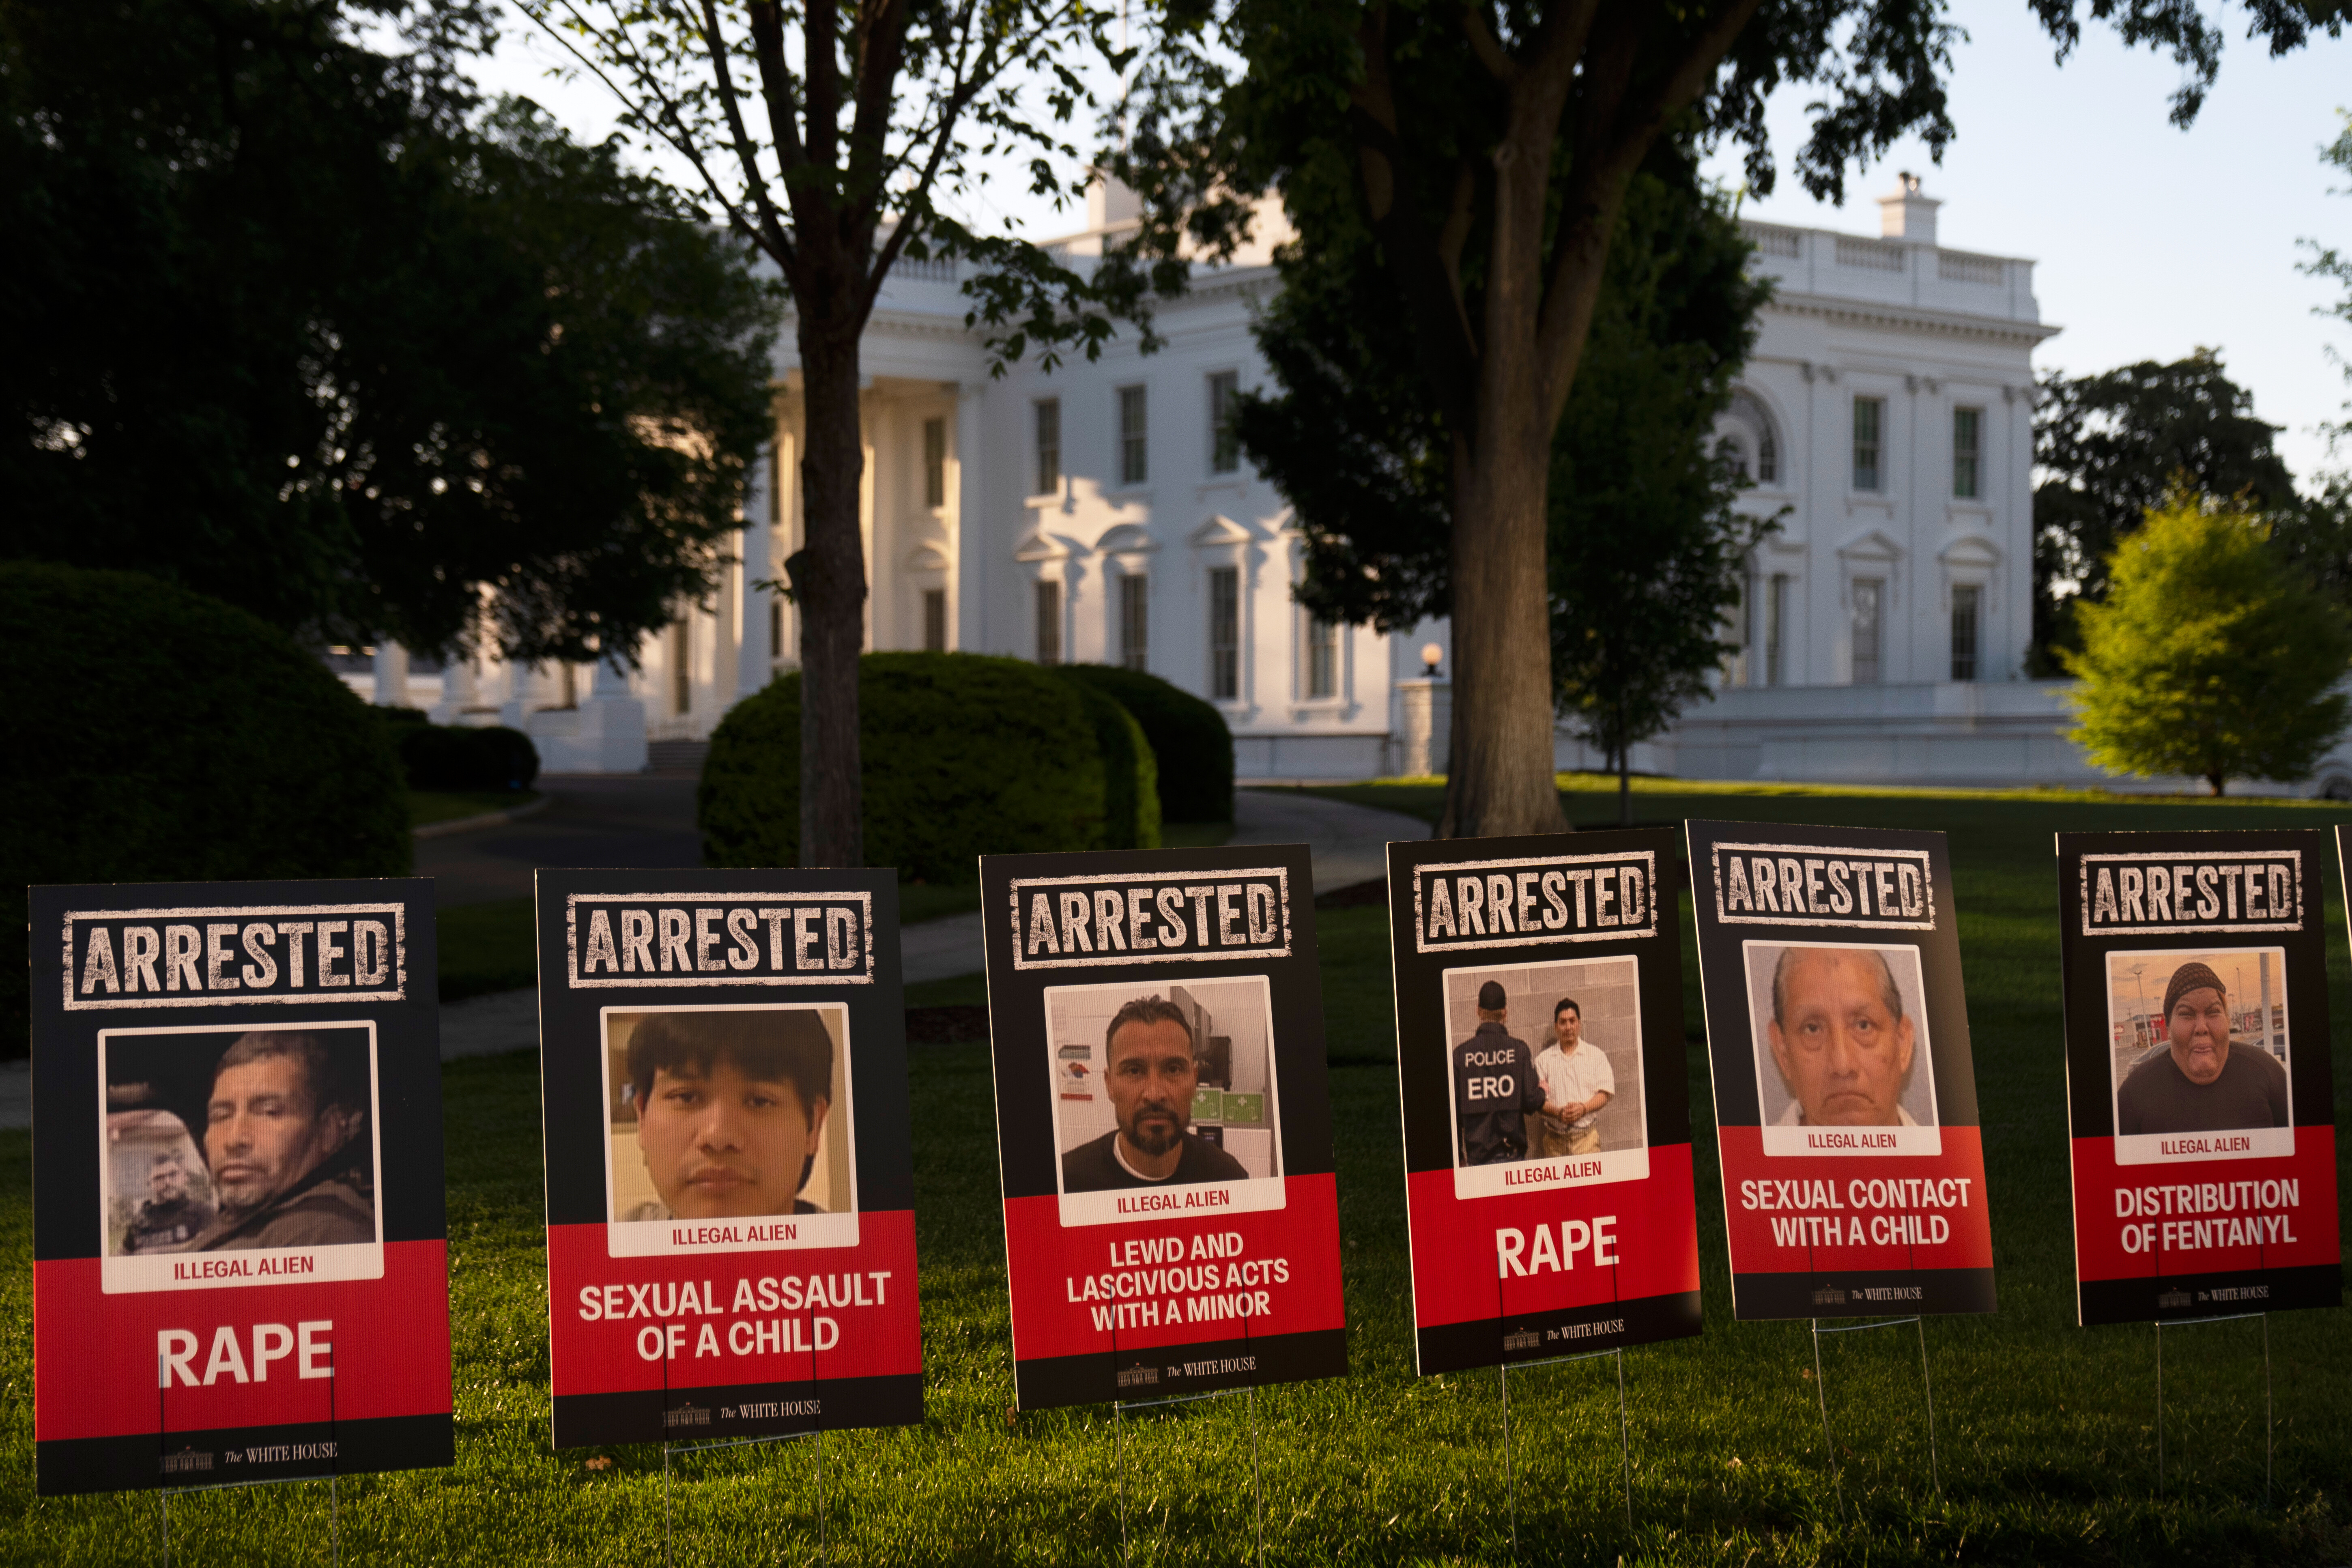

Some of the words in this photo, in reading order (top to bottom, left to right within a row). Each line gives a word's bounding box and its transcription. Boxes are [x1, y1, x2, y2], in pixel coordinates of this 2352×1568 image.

[1429, 867, 1645, 937] ARRESTED
[1729, 856, 1923, 917] ARRESTED
[2094, 865, 2291, 922] ARRESTED
[1028, 884, 1277, 954] ARRESTED
[585, 908, 858, 972] ARRESTED
[82, 921, 388, 993] ARRESTED
[1465, 1049, 1515, 1067] POLICE
[1468, 1075, 1514, 1099] ERO
[1808, 1134, 1858, 1148] ILLEGAL
[1862, 1134, 1896, 1148] ALIEN
[2161, 1139, 2211, 1155] ILLEGAL
[2214, 1137, 2250, 1152] ALIEN
[1505, 1166, 1560, 1185] ILLEGAL
[1564, 1161, 1601, 1179] ALIEN
[1118, 1194, 1181, 1213] ILLEGAL
[1185, 1190, 1229, 1208] ALIEN
[1741, 1180, 1844, 1209] SEXUAL
[1849, 1179, 1971, 1208] CONTACT
[2116, 1179, 2299, 1217] DISTRIBUTION
[673, 1227, 743, 1245] ILLEGAL
[748, 1224, 796, 1241] ALIEN
[1771, 1217, 1842, 1246] WITH
[1849, 1217, 1866, 1245] A
[1871, 1215, 1949, 1245] CHILD
[2122, 1224, 2156, 1253] OF
[2163, 1215, 2297, 1250] FENTANYL
[1110, 1237, 1184, 1267] LEWD
[1191, 1232, 1243, 1260] AND
[1496, 1216, 1619, 1278] RAPE
[175, 1260, 253, 1280] ILLEGAL
[258, 1256, 313, 1275] ALIEN
[1067, 1265, 1219, 1302] LASCIVIOUS
[1225, 1258, 1289, 1288] ACTS
[579, 1281, 723, 1321] SEXUAL
[733, 1272, 891, 1312] ASSAULT
[1852, 1289, 1863, 1299] The
[1865, 1288, 1892, 1300] WHITE
[1894, 1287, 1922, 1299] HOUSE
[2198, 1292, 2209, 1301] The
[2211, 1288, 2239, 1301] WHITE
[2240, 1286, 2269, 1299] HOUSE
[1091, 1301, 1159, 1331] WITH
[1165, 1299, 1182, 1324] A
[1187, 1291, 1271, 1322] MINOR
[637, 1325, 685, 1360] OF
[696, 1323, 720, 1357] A
[729, 1317, 839, 1355] CHILD
[1547, 1330, 1559, 1340] The
[1561, 1323, 1591, 1339] WHITE
[1593, 1319, 1624, 1335] HOUSE
[158, 1320, 334, 1387] RAPE
[1167, 1366, 1181, 1377] The
[1184, 1360, 1218, 1376] WHITE
[1220, 1356, 1256, 1373] HOUSE
[721, 1407, 736, 1418] The
[740, 1403, 778, 1418] WHITE
[781, 1400, 820, 1416] HOUSE
[225, 1451, 242, 1463] The
[246, 1445, 289, 1463] WHITE
[293, 1442, 337, 1460] HOUSE
